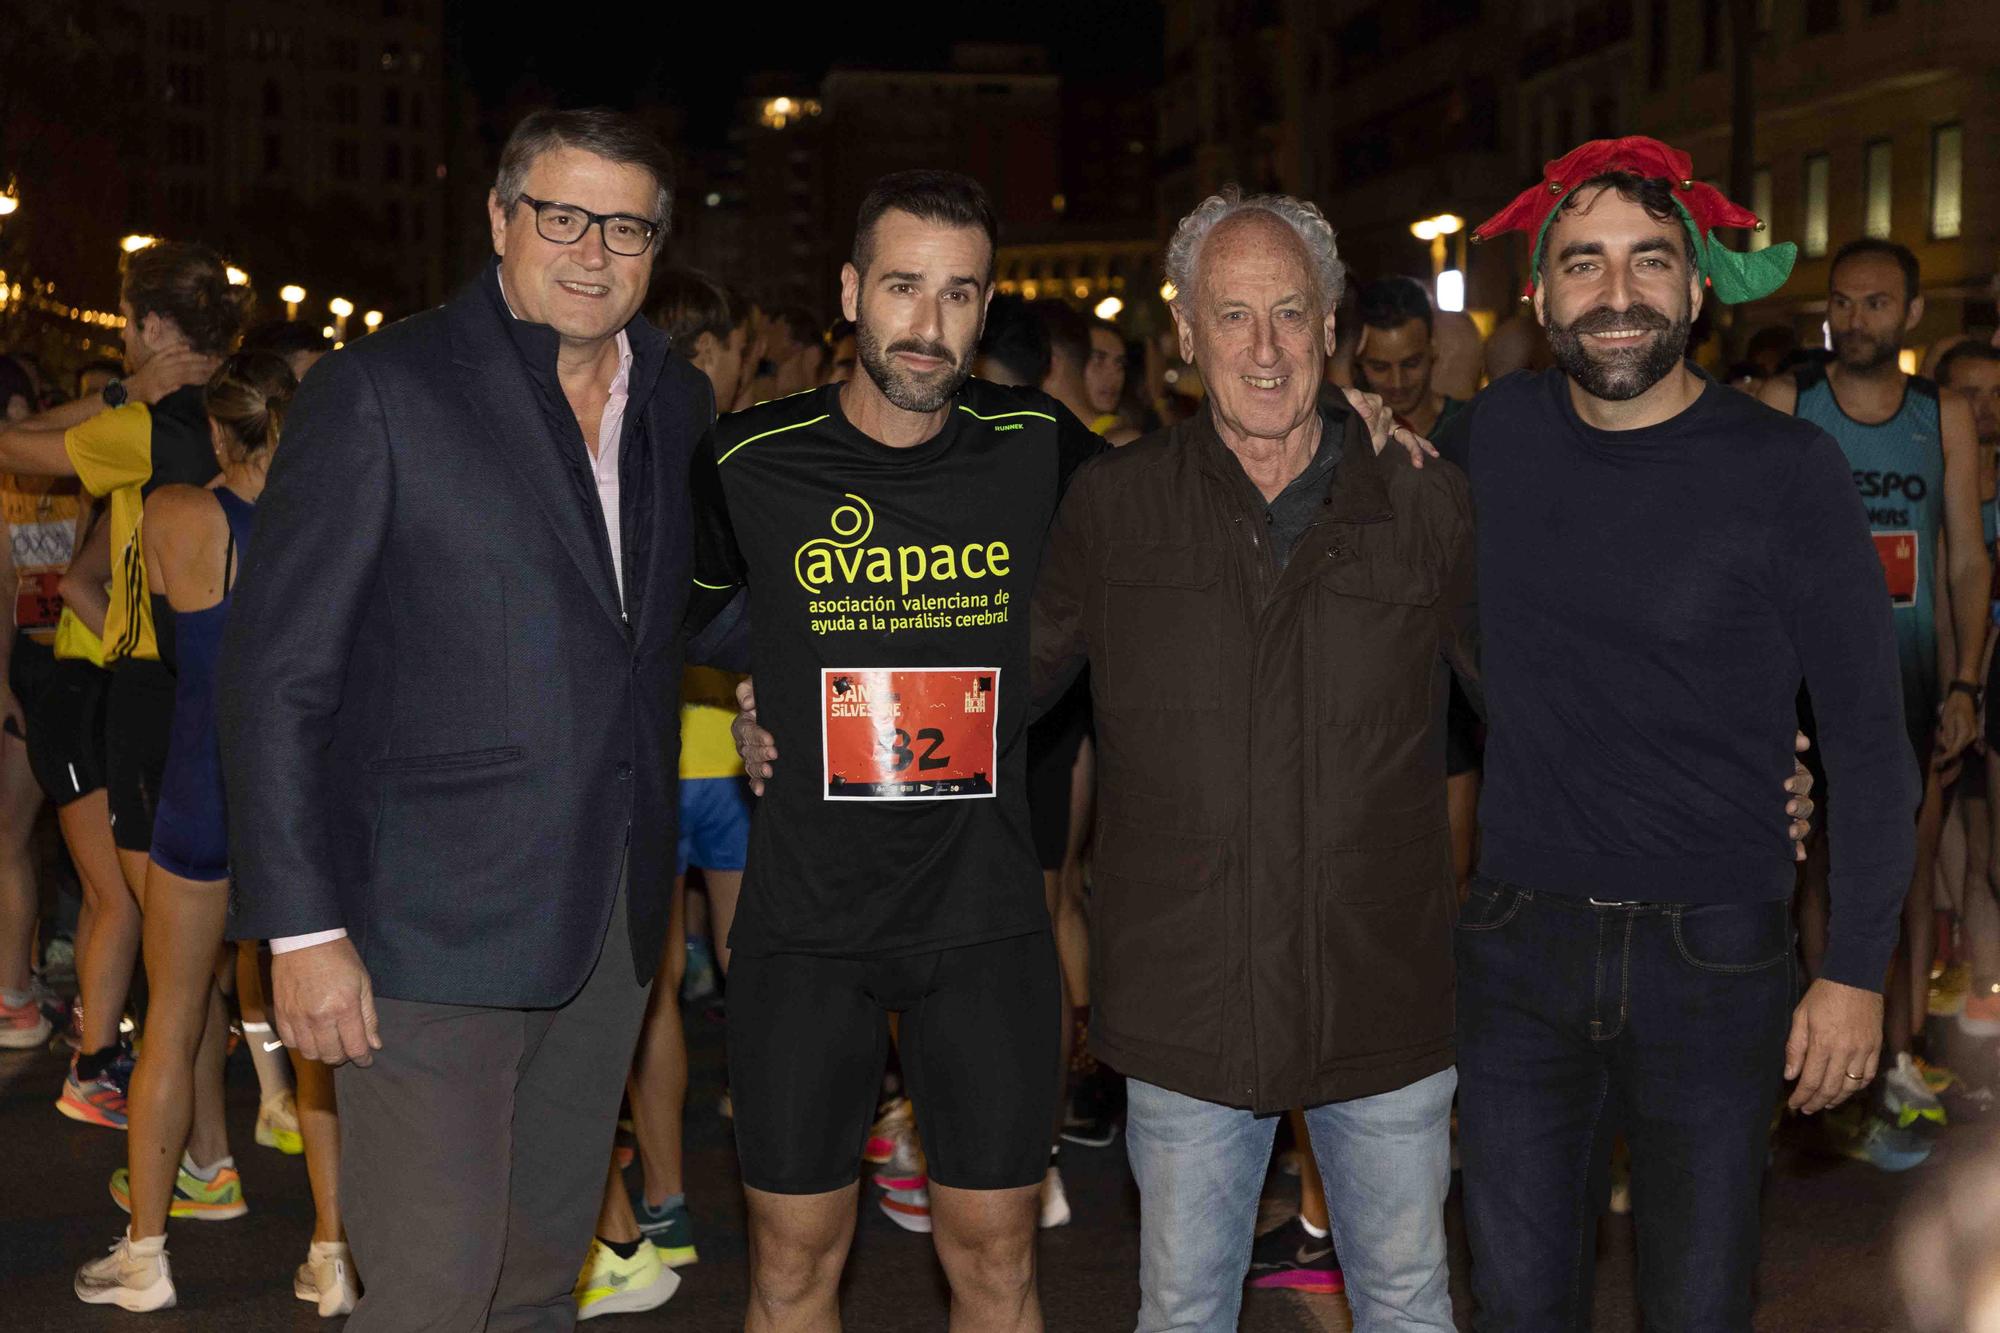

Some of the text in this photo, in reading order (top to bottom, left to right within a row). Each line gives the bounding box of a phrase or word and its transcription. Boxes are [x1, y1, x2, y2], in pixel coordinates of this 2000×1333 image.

[806, 541, 1010, 596] avapace
[808, 588, 1010, 614] asociación valenciana de
[810, 607, 1010, 636] ayuda a la parálisis cerebral
